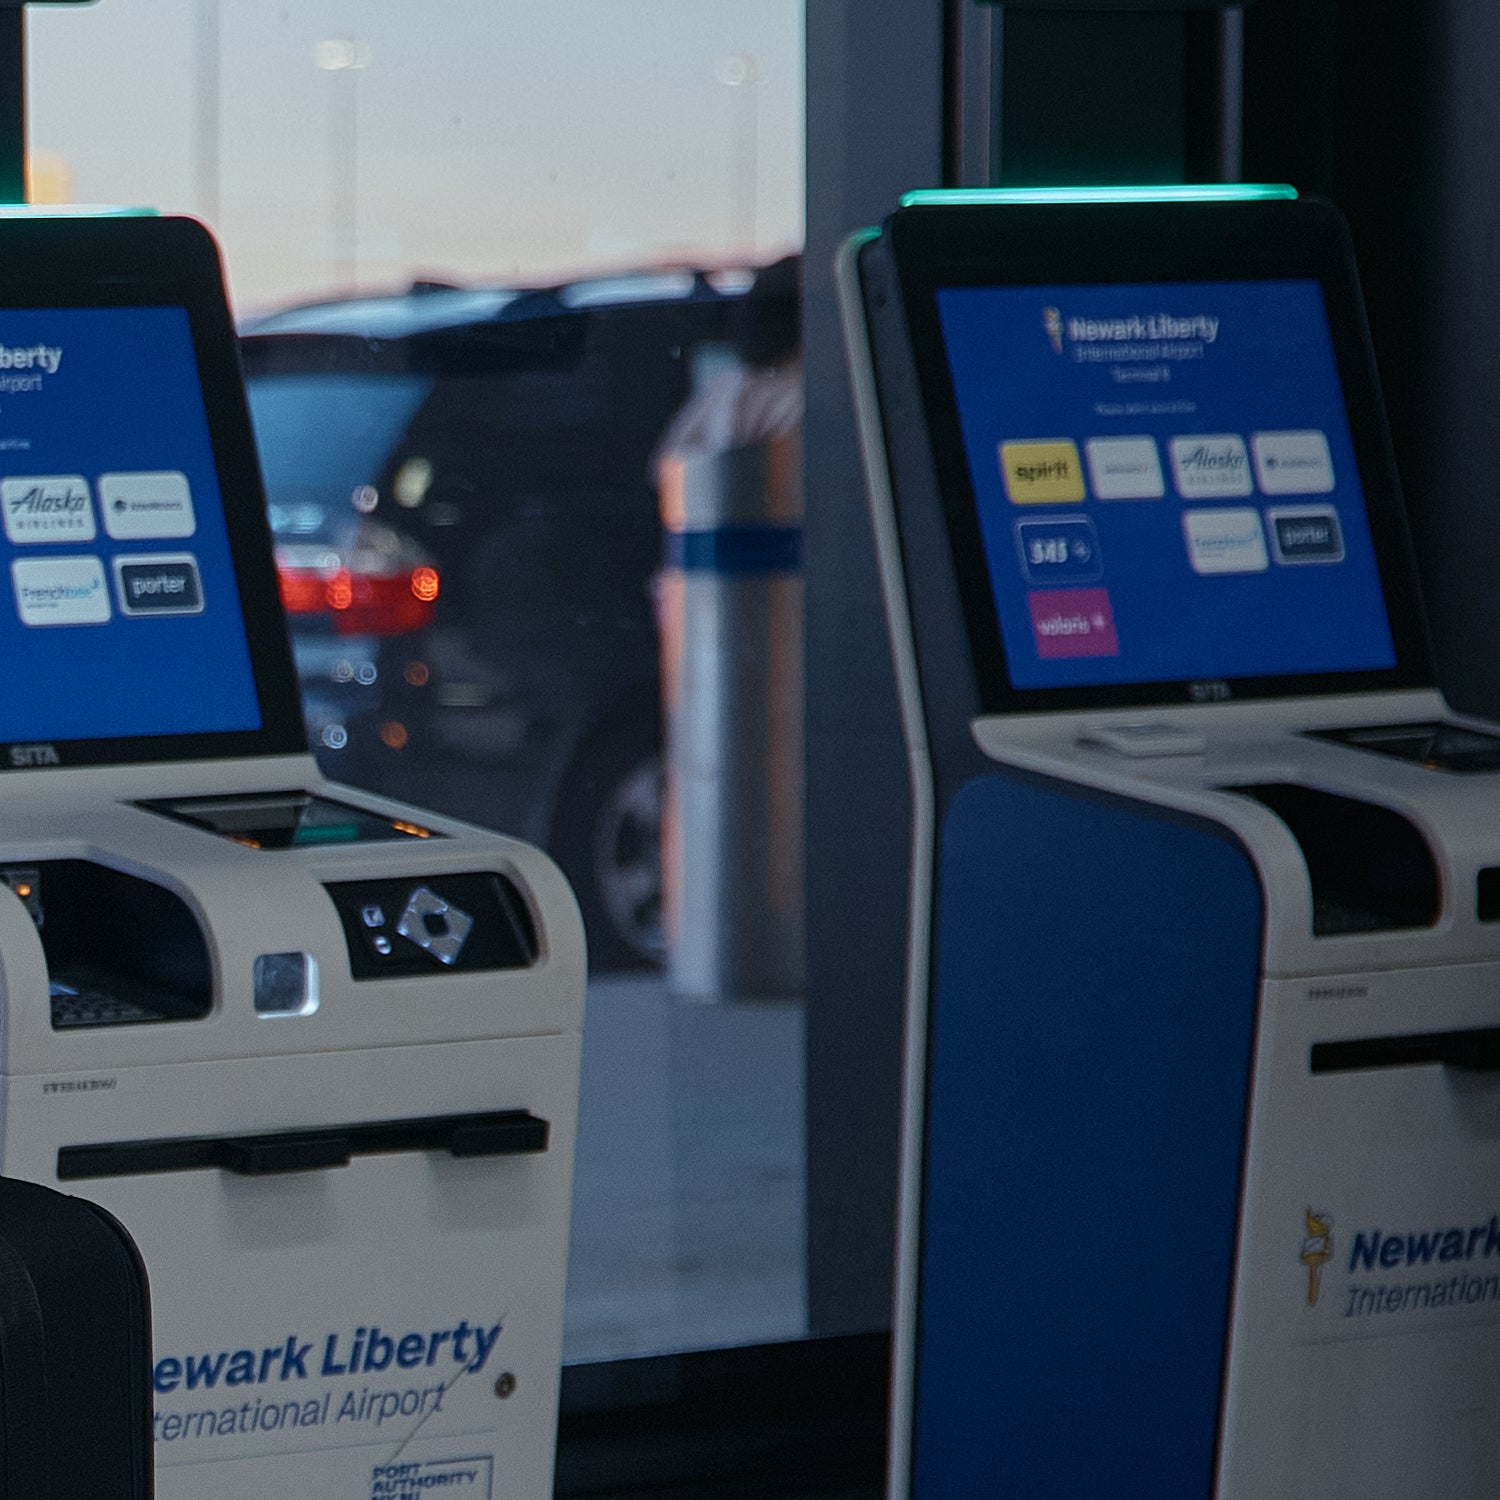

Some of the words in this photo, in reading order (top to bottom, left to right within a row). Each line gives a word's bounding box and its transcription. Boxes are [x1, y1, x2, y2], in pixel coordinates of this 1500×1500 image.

[1069, 314, 1146, 341] Newark
[1147, 312, 1220, 344] Liberty
[9, 486, 86, 514] Alaska
[132, 575, 186, 599] porter
[9, 744, 60, 766] SITA
[153, 1336, 313, 1394] ewark
[321, 1321, 503, 1377] Liberty
[153, 1393, 331, 1441] ternational
[337, 1381, 446, 1425] Airport
[372, 1463, 420, 1479] PORT
[372, 1470, 479, 1493] AUTHORITY
